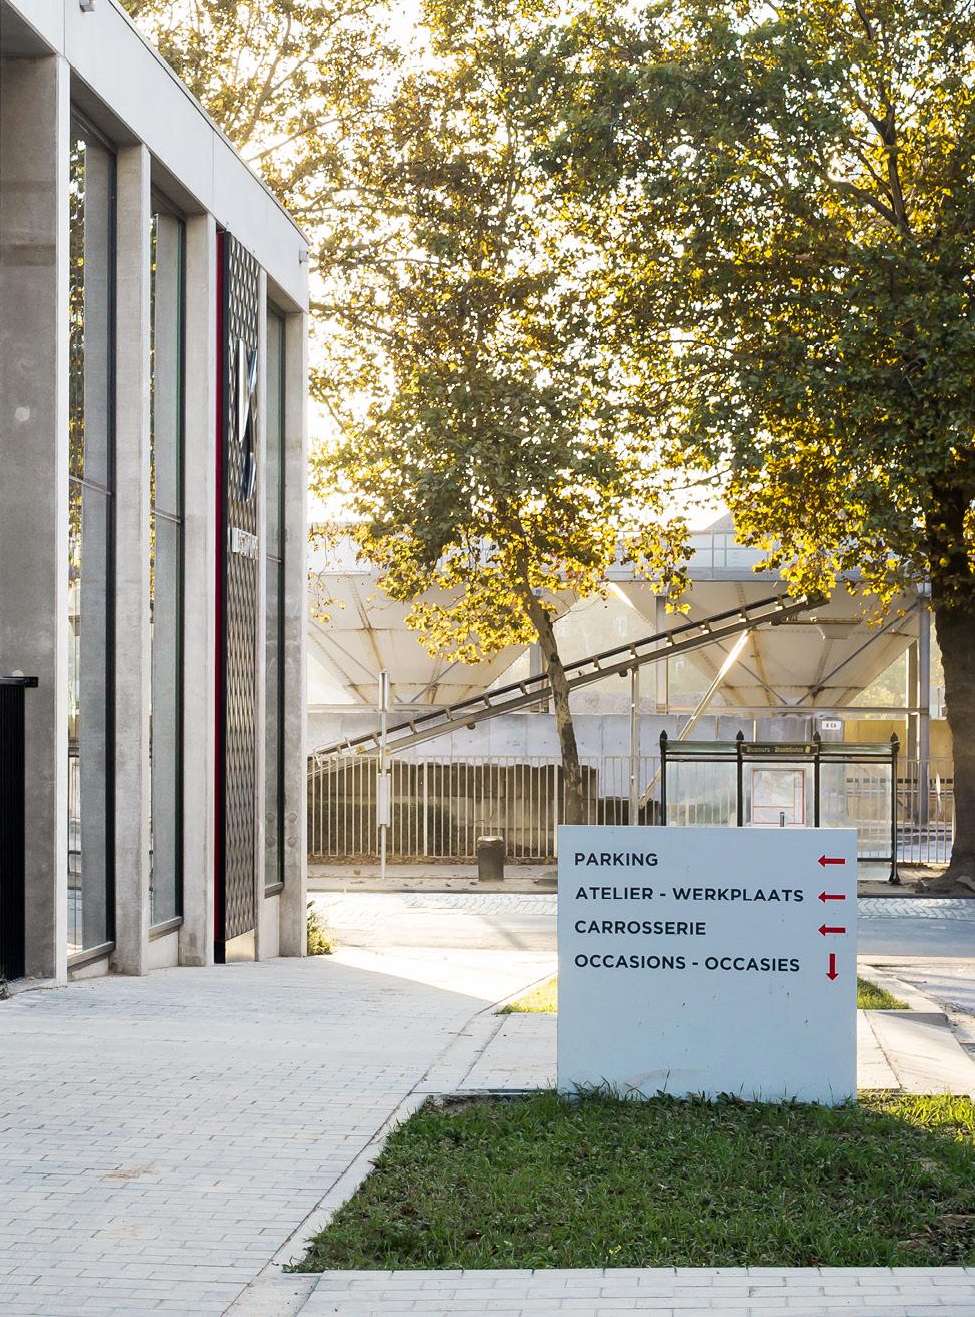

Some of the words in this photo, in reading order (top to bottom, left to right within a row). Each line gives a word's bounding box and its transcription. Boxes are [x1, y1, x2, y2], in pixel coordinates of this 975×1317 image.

[574, 852, 658, 867] PARKING
[575, 886, 654, 900] ATELIER
[672, 887, 804, 903] WERKPLAATS
[574, 920, 706, 936] CARROSSERIE
[574, 953, 686, 970] OCCASIONS
[704, 956, 800, 973] OCCASIES
